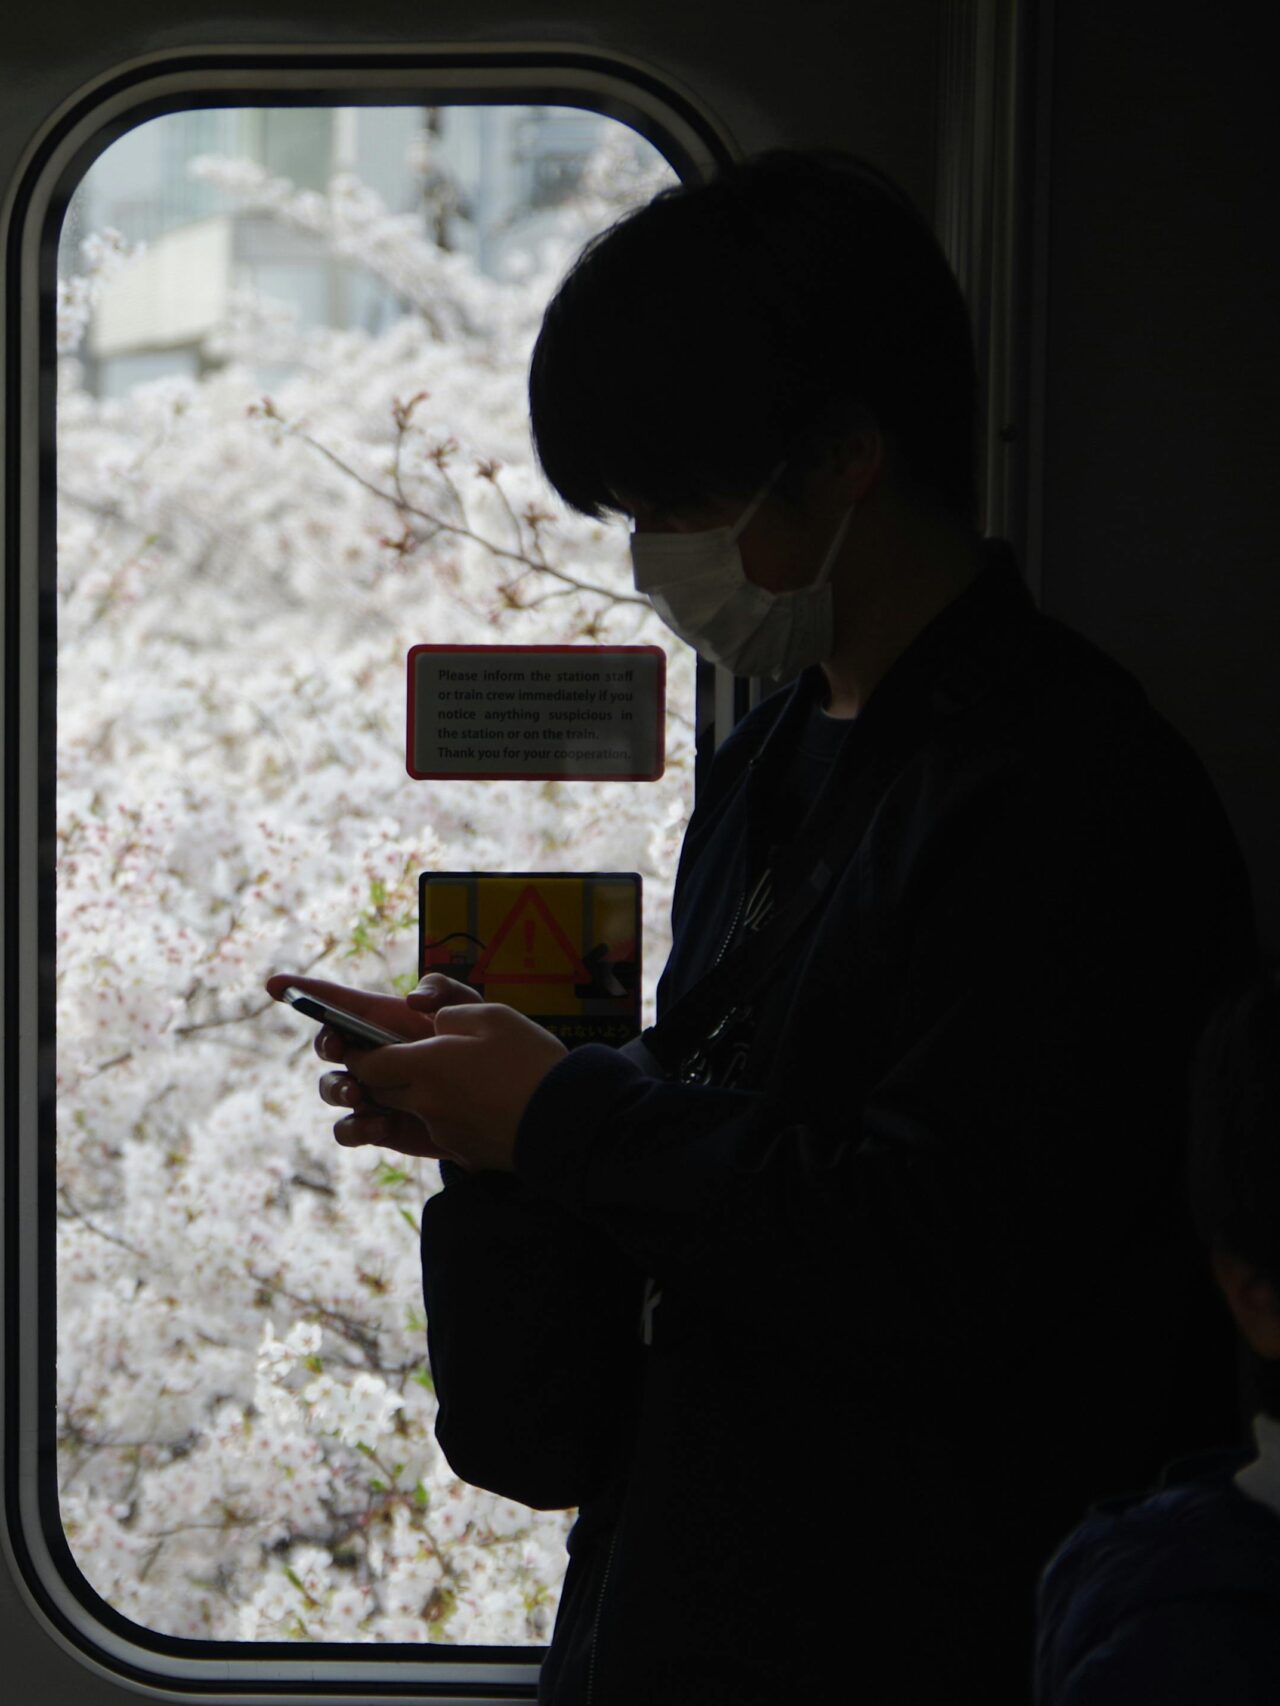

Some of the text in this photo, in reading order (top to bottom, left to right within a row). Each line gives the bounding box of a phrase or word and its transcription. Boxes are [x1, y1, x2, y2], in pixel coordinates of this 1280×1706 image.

[439, 670, 477, 681] Please
[484, 670, 524, 681] inform
[531, 670, 551, 681] the
[558, 670, 600, 681] station
[439, 689, 633, 703] or train crew immediately if you
[439, 709, 632, 723] notice anything suspicious in
[439, 729, 458, 740] the
[462, 729, 504, 740] station
[508, 731, 520, 740] or
[524, 731, 539, 740] on
[543, 729, 563, 740] the
[438, 747, 474, 759] Thank
[478, 750, 500, 762] you
[504, 747, 520, 759] for
[524, 750, 551, 762] your
